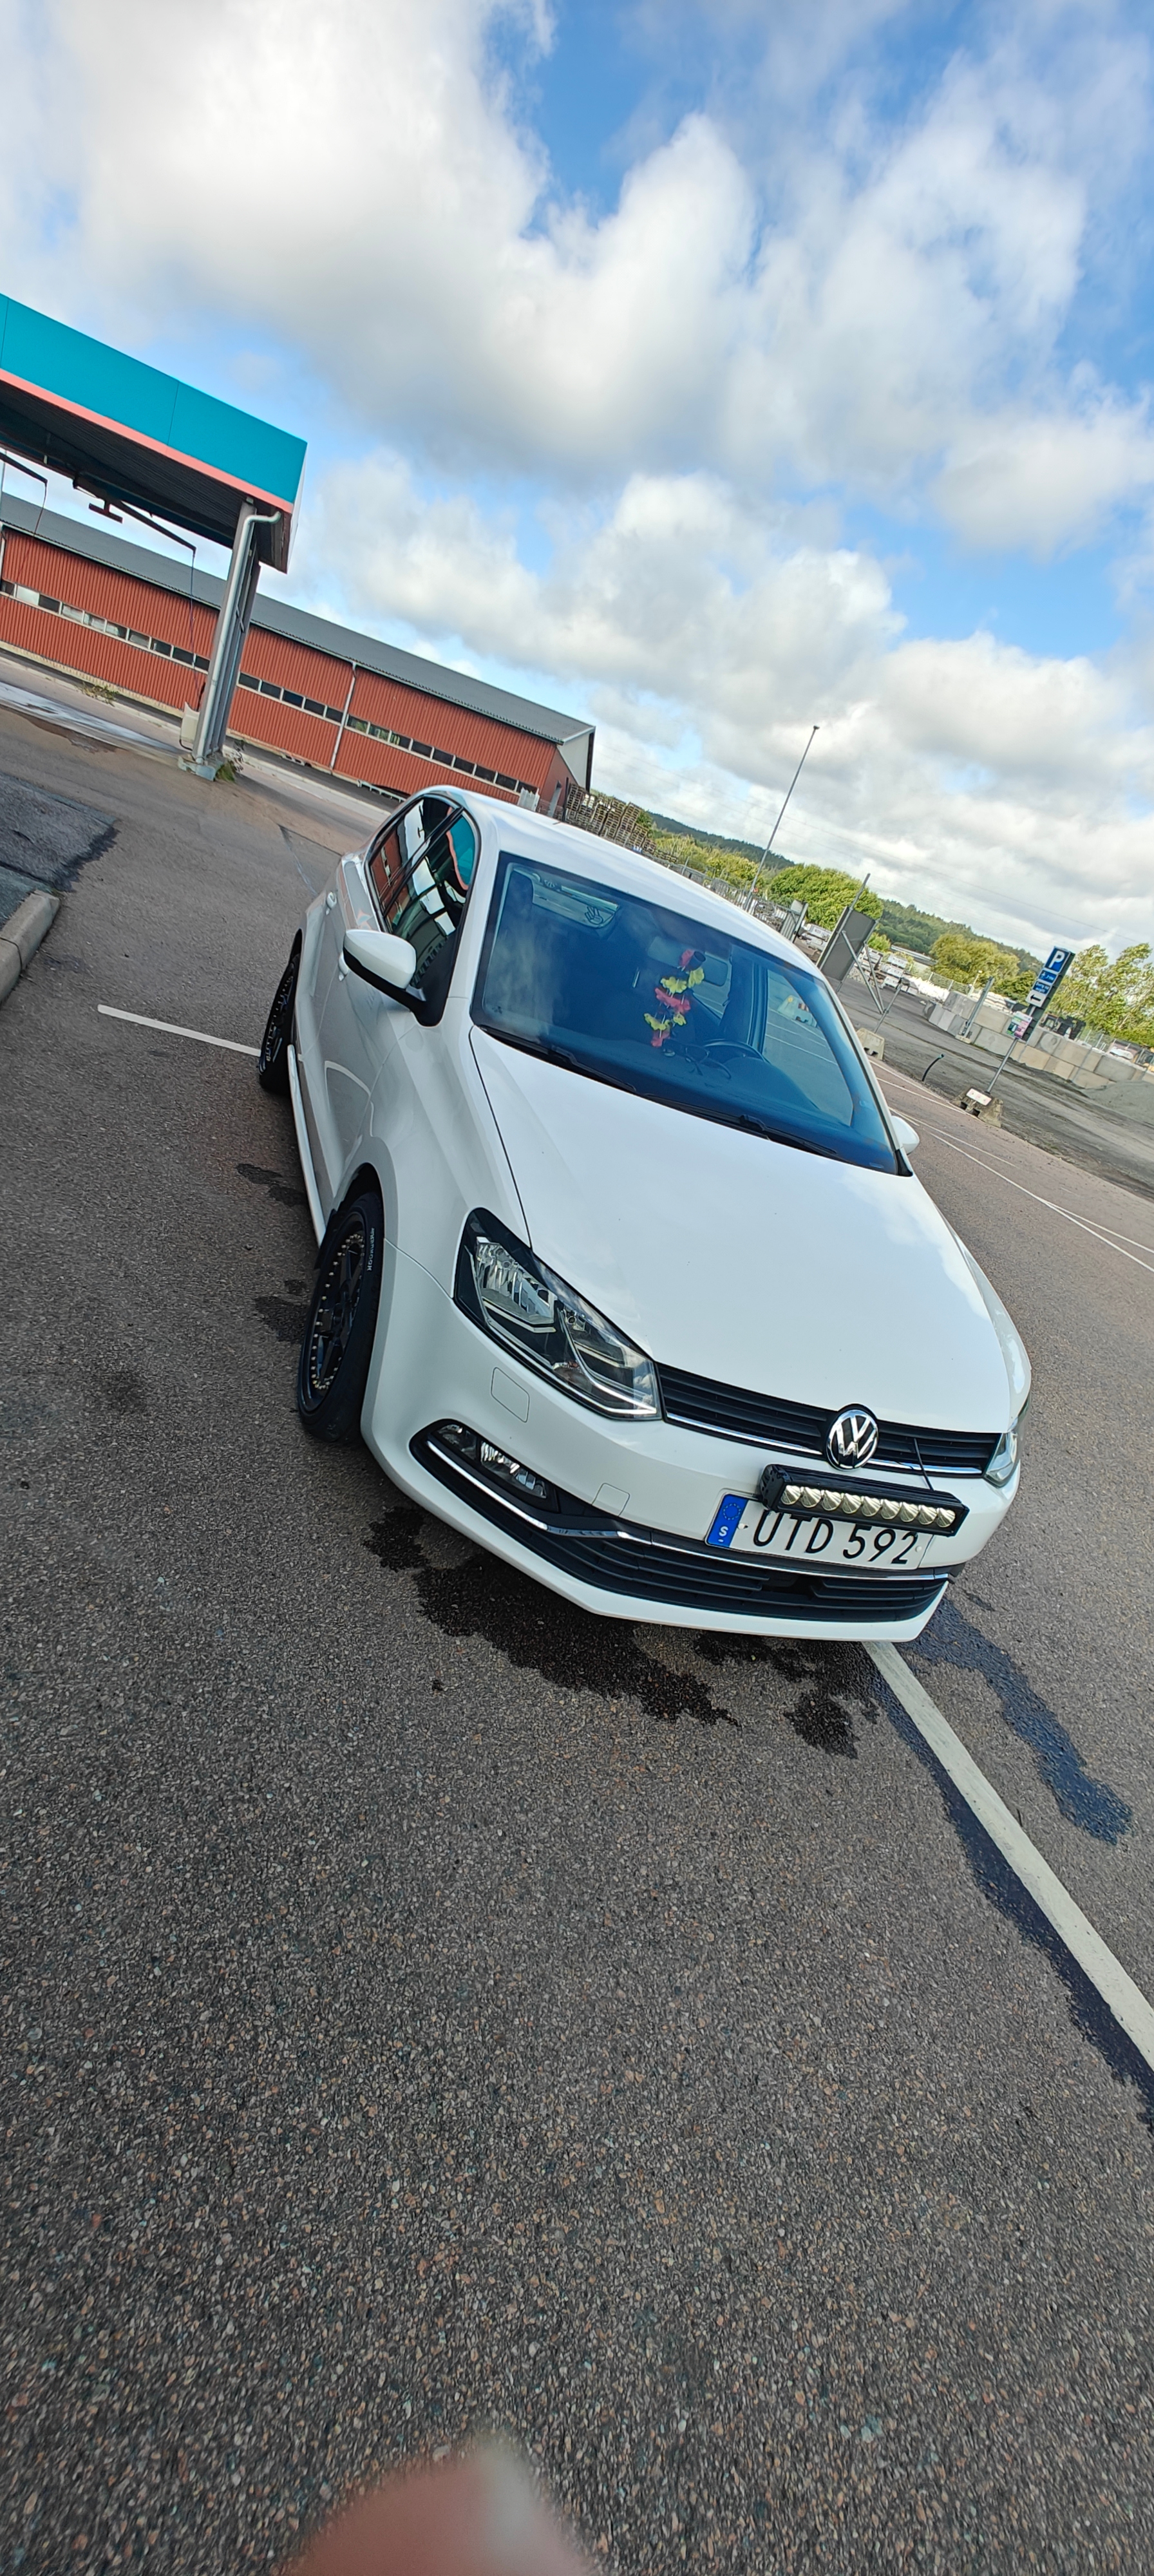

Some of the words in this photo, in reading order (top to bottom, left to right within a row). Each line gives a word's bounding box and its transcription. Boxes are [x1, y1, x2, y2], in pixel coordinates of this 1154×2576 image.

[1048, 950, 1066, 969] P
[828, 1410, 878, 1463] VW
[719, 1526, 729, 1537] S
[753, 1510, 834, 1554] UTD
[842, 1524, 918, 1565] 592
